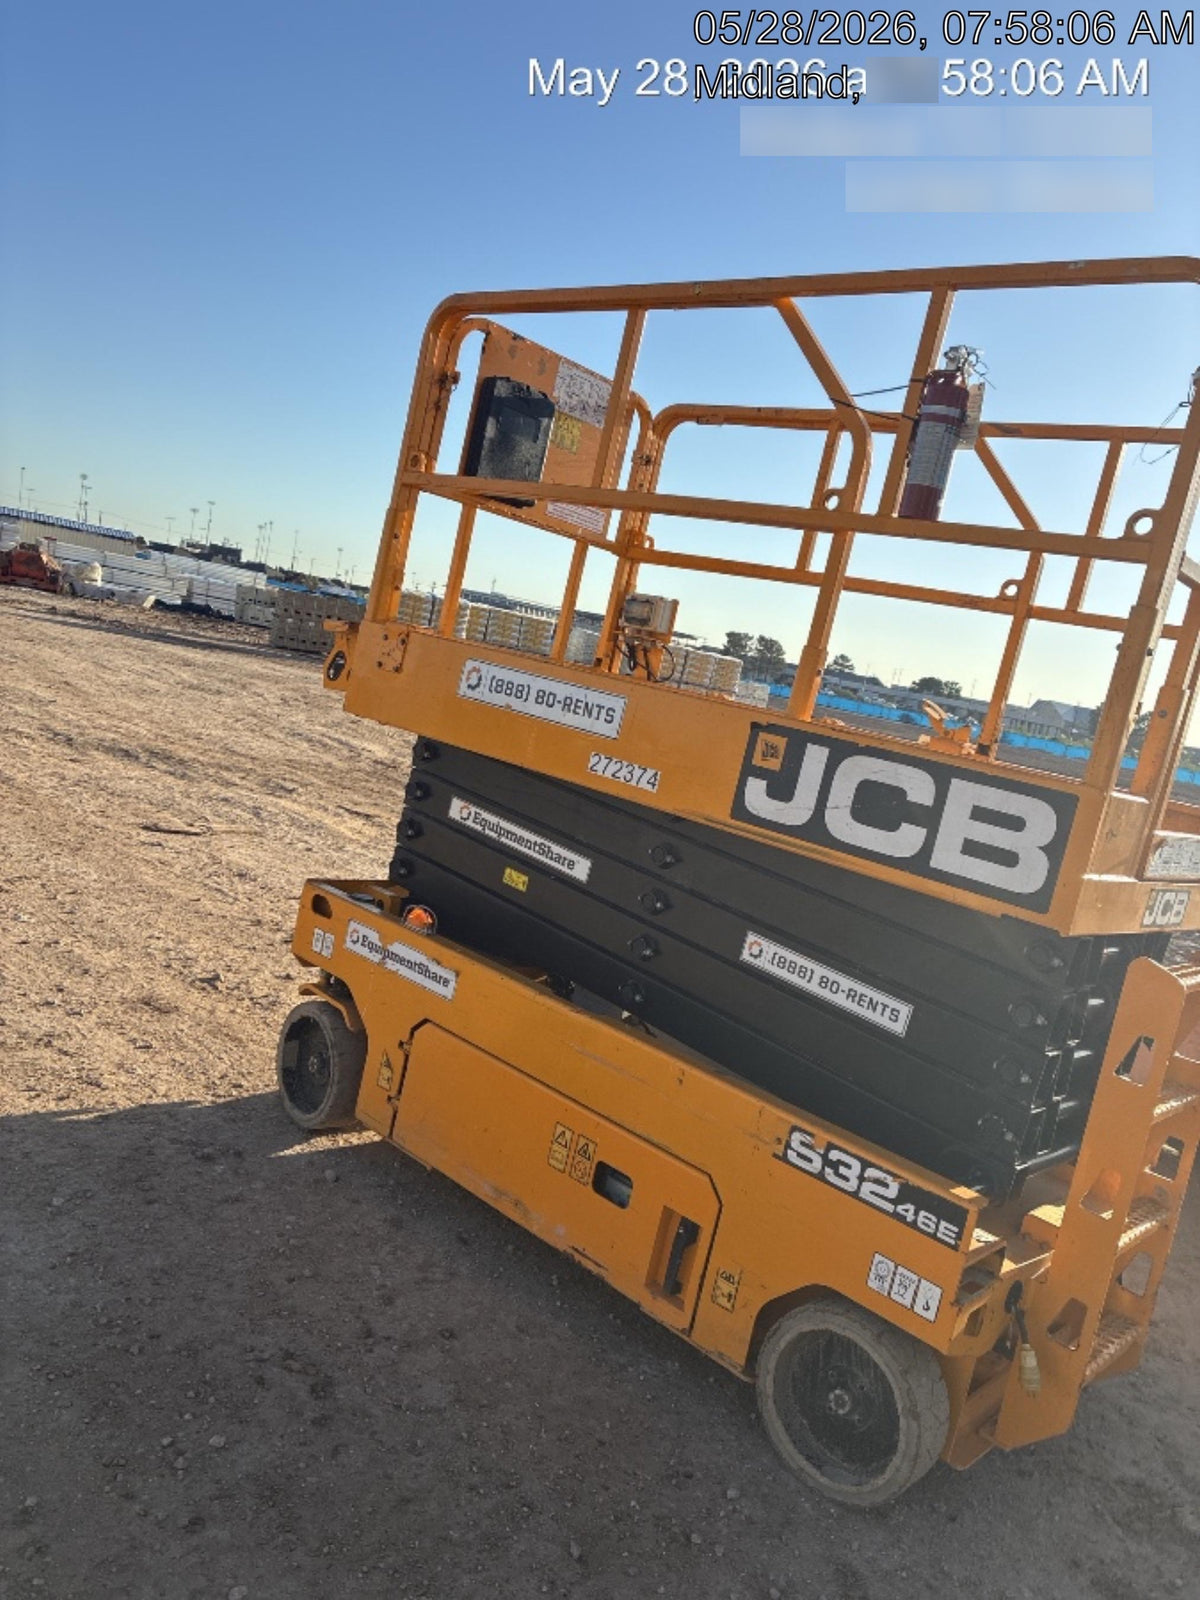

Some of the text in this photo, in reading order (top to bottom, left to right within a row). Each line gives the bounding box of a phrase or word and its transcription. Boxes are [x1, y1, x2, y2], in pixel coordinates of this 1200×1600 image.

[488, 675, 617, 724] (888) 80-RENTS
[589, 753, 660, 790] 272374
[472, 810, 577, 871] EquipmentShare
[744, 743, 1058, 894] JCB
[1143, 891, 1190, 926] JCB
[360, 934, 451, 988] EquipmentShare
[769, 952, 901, 1023] (888) 80-RENTS
